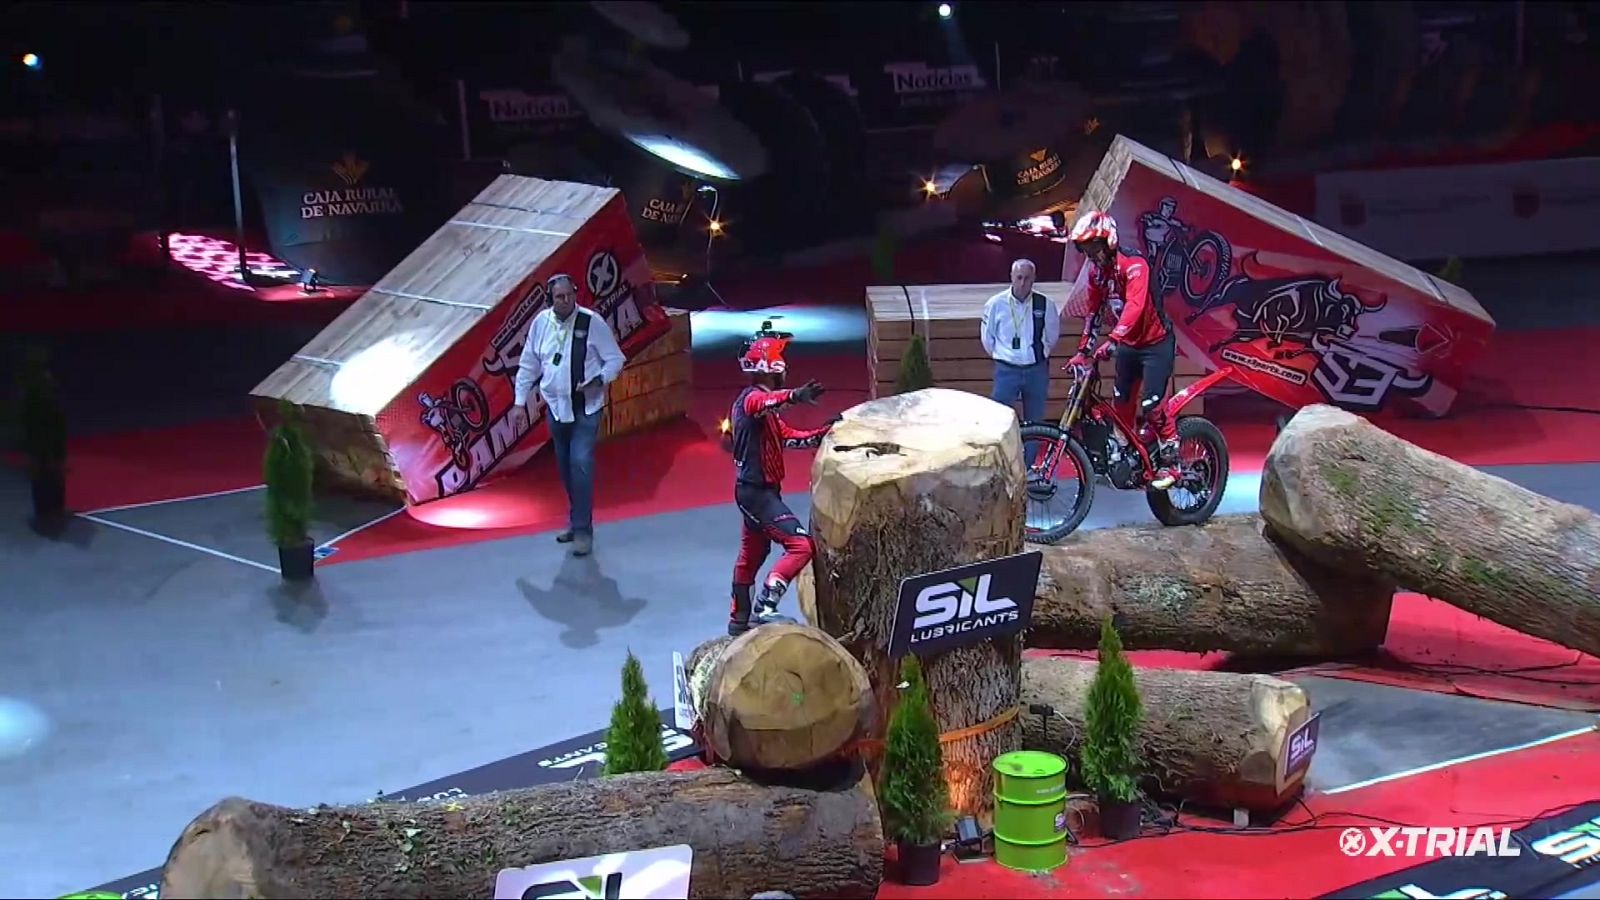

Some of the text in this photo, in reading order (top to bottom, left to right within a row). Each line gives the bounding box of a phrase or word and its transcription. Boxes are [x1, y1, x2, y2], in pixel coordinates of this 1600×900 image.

[493, 100, 568, 118] Noticia
[302, 186, 395, 205] CAJA RURAL
[301, 200, 404, 219] DE NAVARRA
[914, 574, 1018, 629] SIL
[911, 611, 1019, 643] LUBRICANTS
